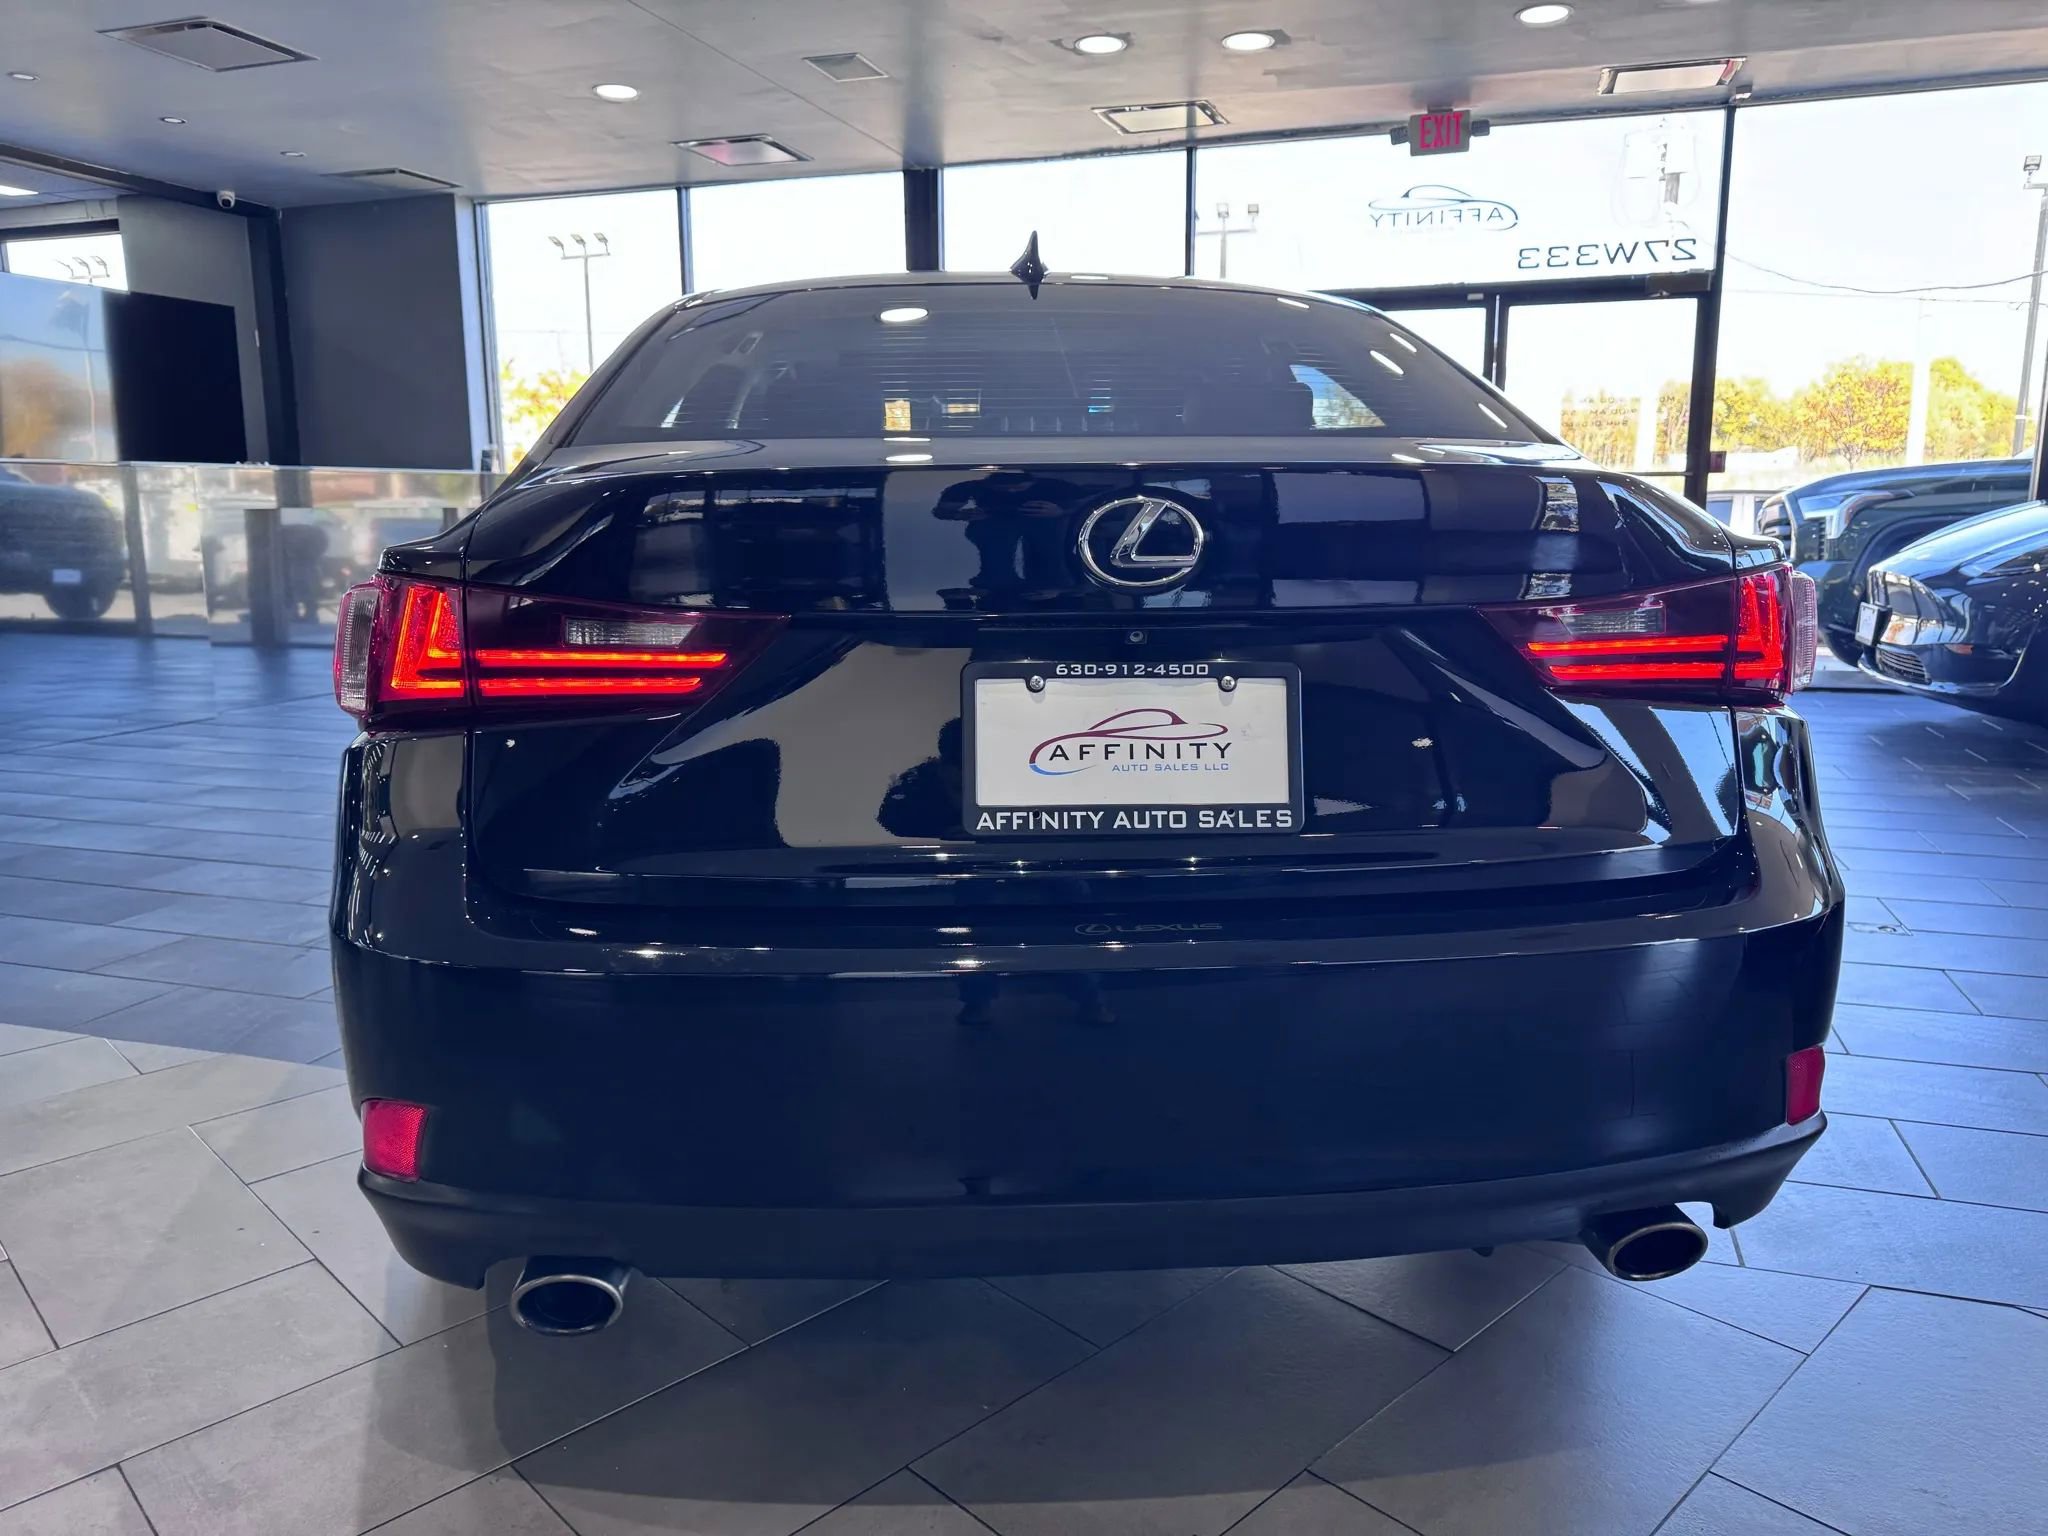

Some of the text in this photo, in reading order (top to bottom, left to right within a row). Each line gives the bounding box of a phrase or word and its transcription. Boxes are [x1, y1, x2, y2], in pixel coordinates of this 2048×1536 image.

[1419, 111, 1464, 150] EXIT
[1055, 663, 1210, 677] 630-912-4500
[1048, 742, 1232, 761] AFFINITY
[1111, 762, 1229, 773] AUTO SALES LLC
[975, 808, 1293, 831] AFFINITY AUTO SALES
[1115, 922, 1223, 932] LEXUS
